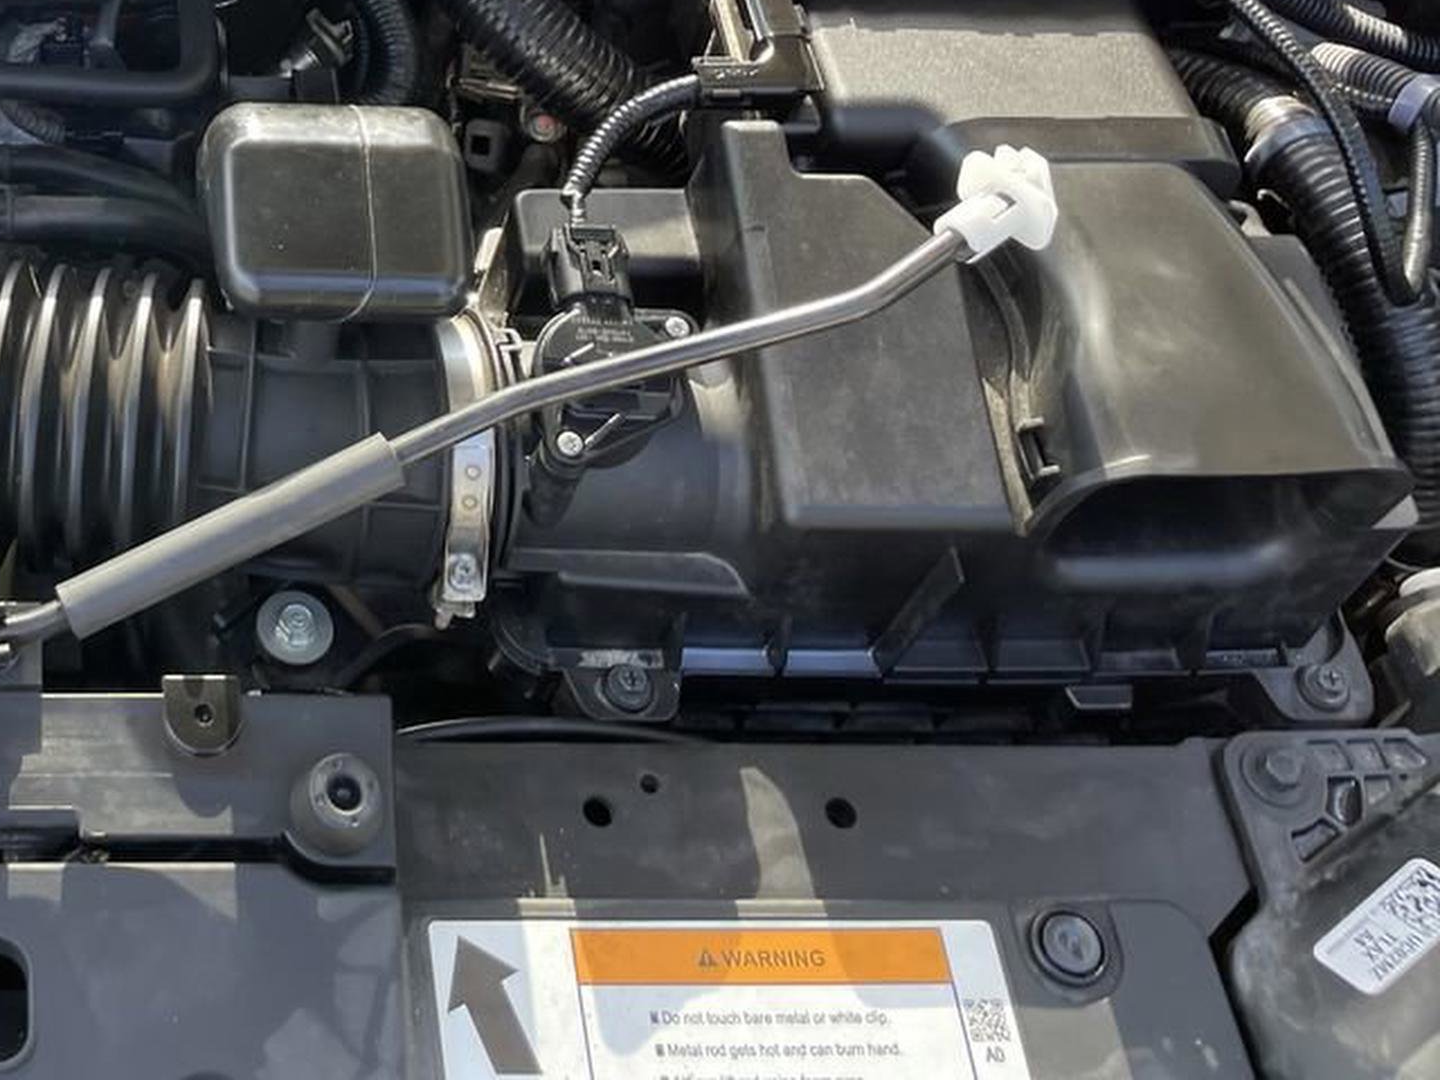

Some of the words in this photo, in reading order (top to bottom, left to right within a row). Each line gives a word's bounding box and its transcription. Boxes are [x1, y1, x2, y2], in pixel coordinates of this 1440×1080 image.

[721, 948, 826, 968] WARNING
[662, 1010, 680, 1025] Do
[684, 1011, 704, 1025] not
[706, 1011, 740, 1025] touch
[743, 1010, 772, 1025] bare
[775, 1011, 810, 1025] metal
[812, 1012, 825, 1025] or
[829, 1011, 862, 1025] white
[667, 1043, 703, 1057] Metal
[706, 1044, 726, 1057] rod
[729, 1044, 756, 1060] gets
[758, 1044, 780, 1057] hot
[783, 1044, 806, 1057] and
[809, 1045, 833, 1057] can
[834, 1043, 865, 1057] burn
